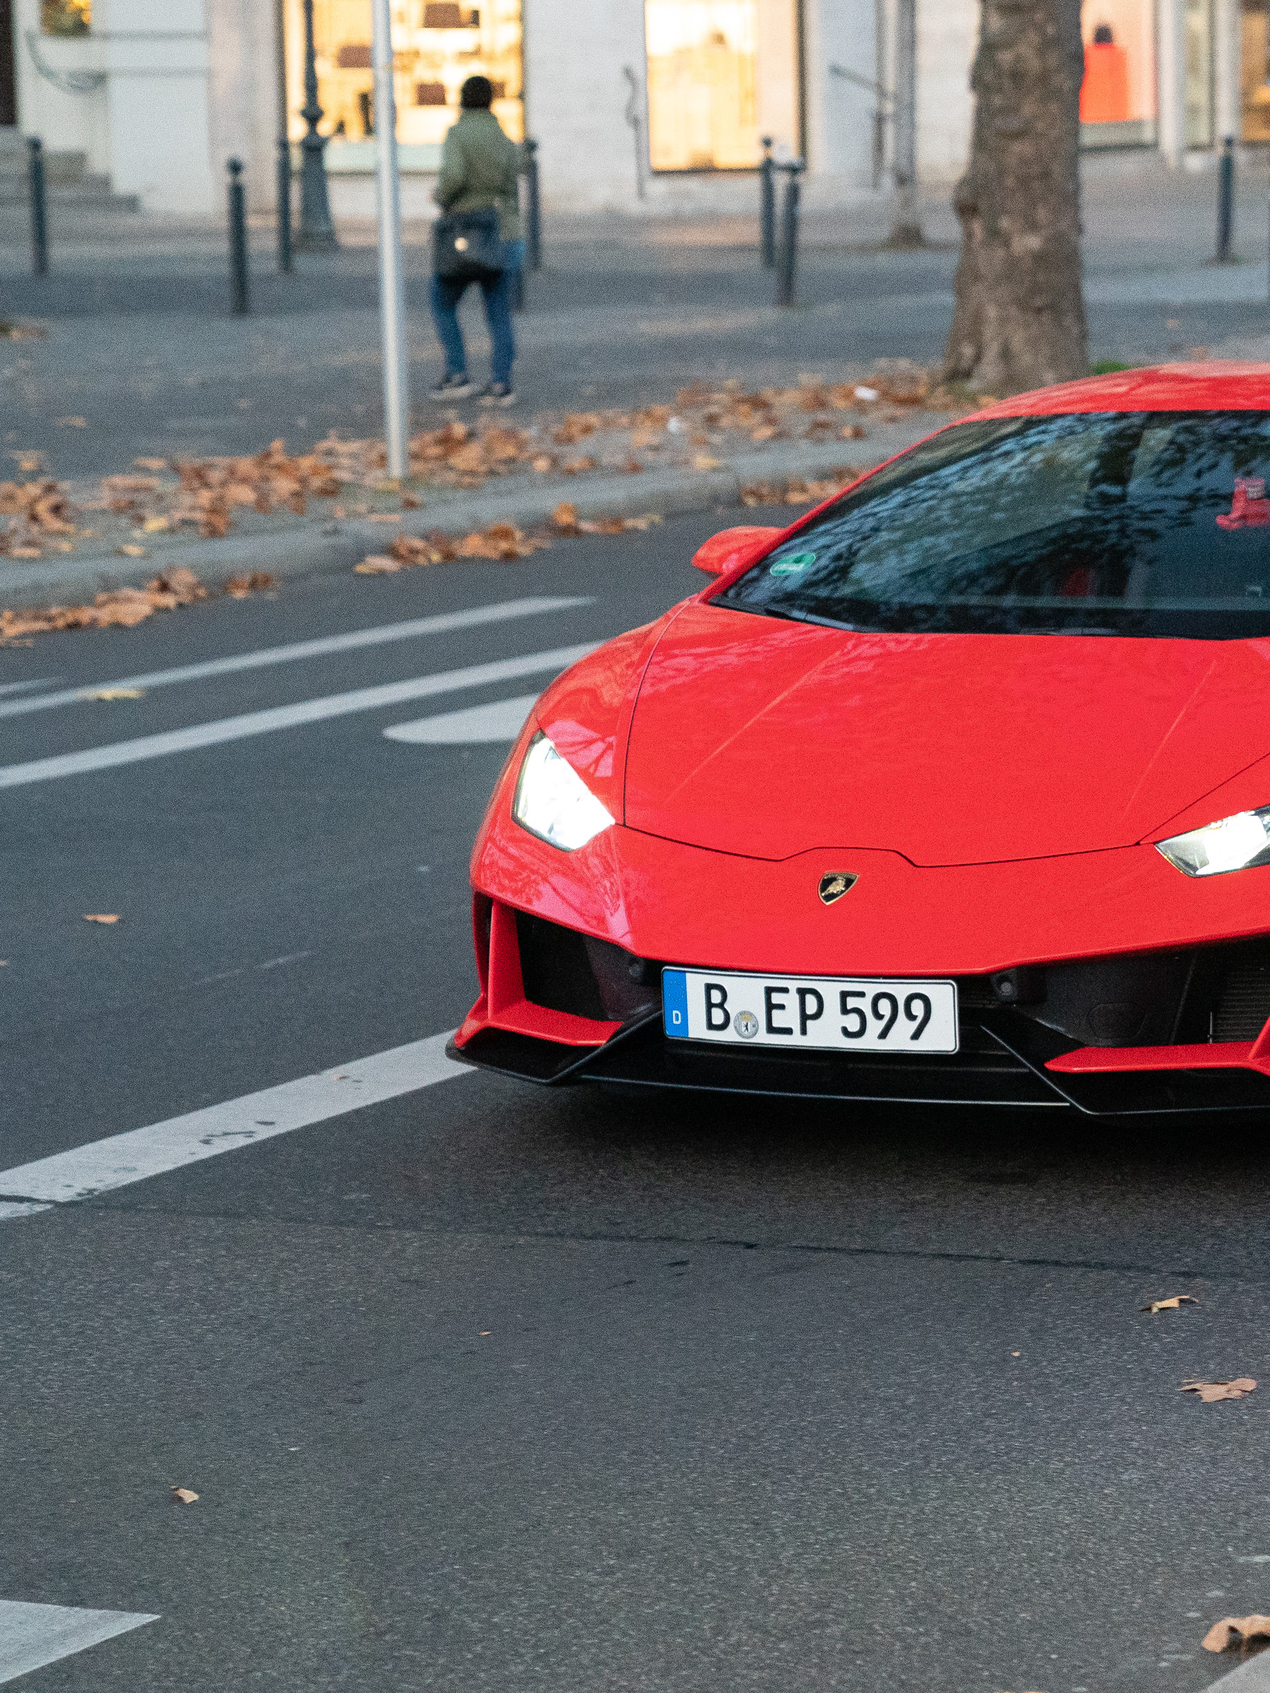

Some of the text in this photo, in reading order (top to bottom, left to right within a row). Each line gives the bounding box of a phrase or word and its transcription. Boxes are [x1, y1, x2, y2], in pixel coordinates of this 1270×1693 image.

[673, 1010, 682, 1025] D
[704, 983, 932, 1041] B EP 599
